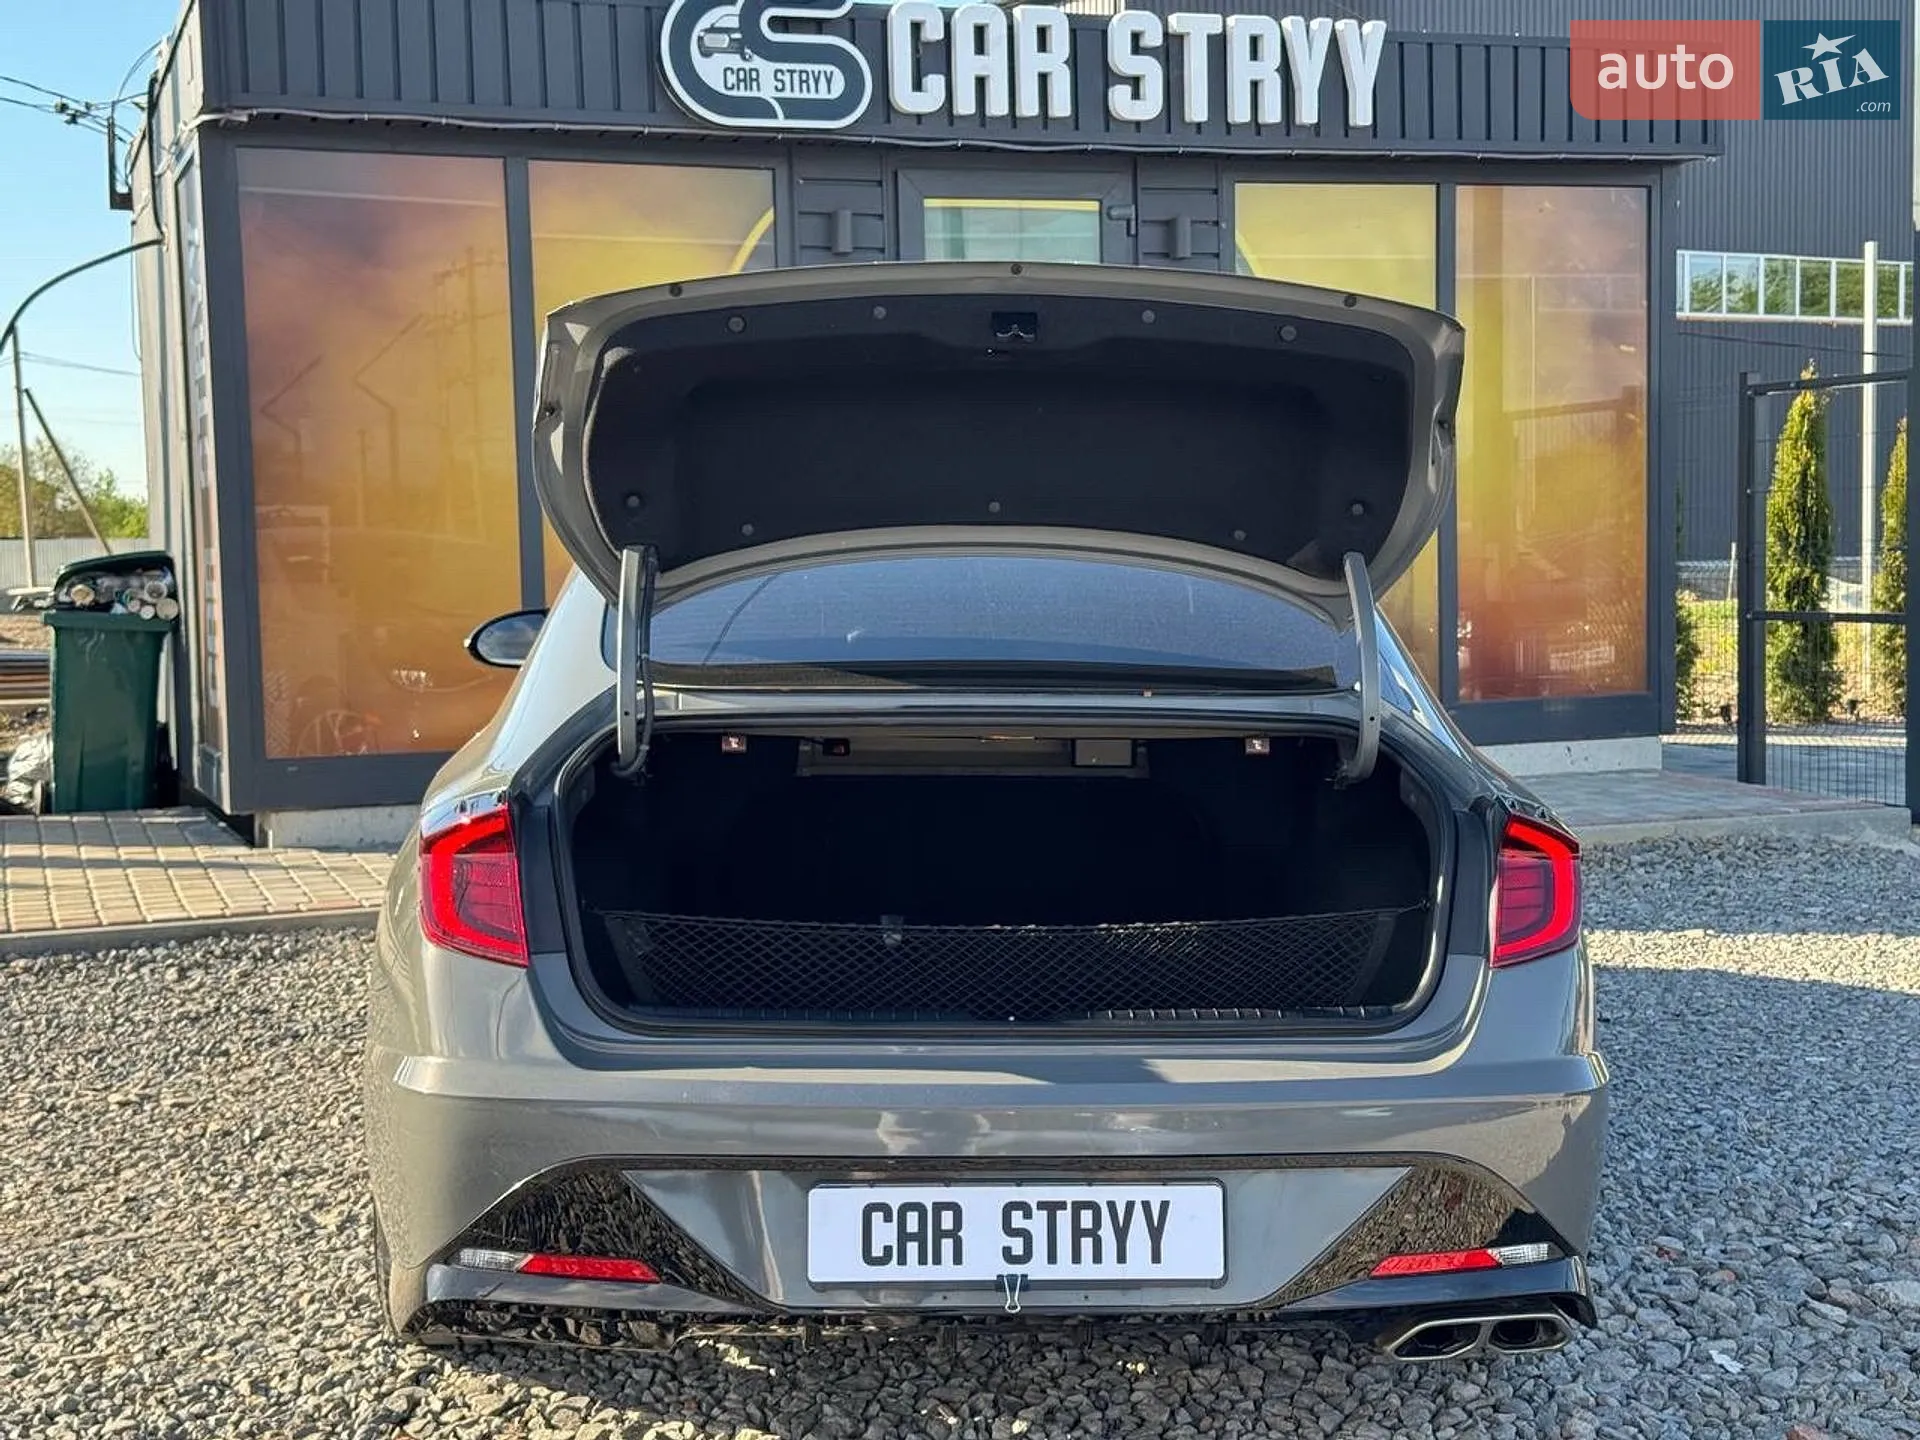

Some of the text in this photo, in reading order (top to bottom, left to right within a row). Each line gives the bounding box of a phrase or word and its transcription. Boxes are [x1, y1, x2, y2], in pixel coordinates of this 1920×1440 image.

[722, 66, 835, 95] CAR STRYY
[886, 1, 1388, 128] CAR STRYY
[861, 1199, 1171, 1267] CAR STRYY
